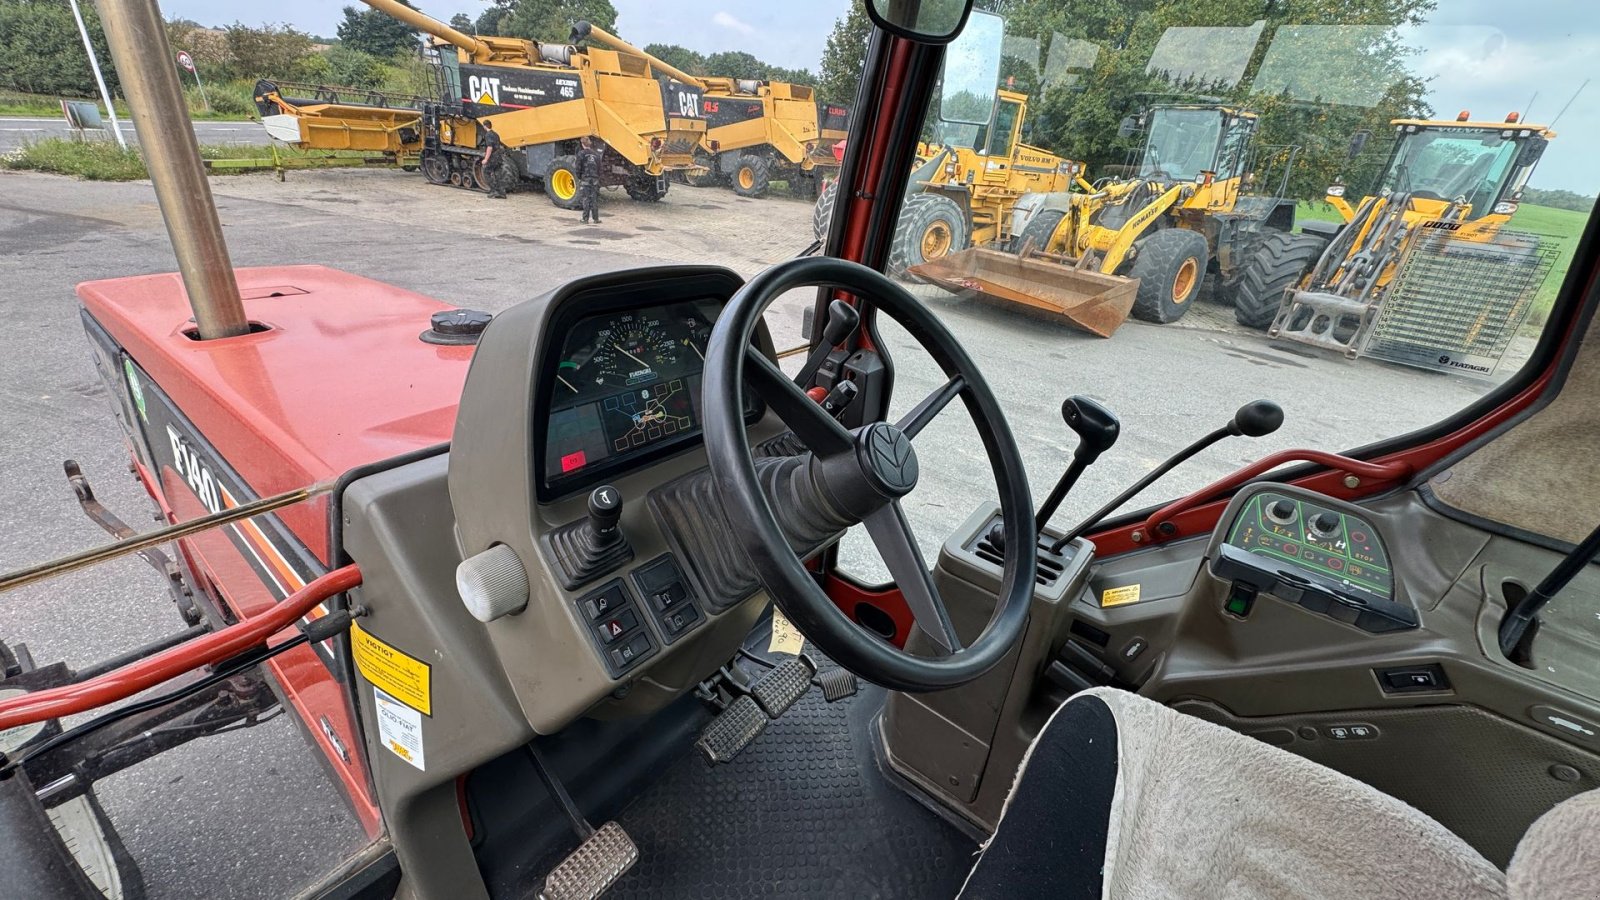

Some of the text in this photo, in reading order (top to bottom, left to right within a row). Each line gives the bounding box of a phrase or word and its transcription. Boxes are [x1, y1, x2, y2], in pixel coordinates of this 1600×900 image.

[468, 75, 500, 106] CAT
[560, 86, 574, 98] 465
[678, 91, 699, 118] CAT
[1020, 155, 1040, 163] VOLVO
[1132, 206, 1158, 229] KOMATSU
[1423, 221, 1461, 231] FIAT
[1449, 361, 1490, 373] FIATAGRI
[166, 424, 221, 513] F140
[1355, 552, 1374, 562] STOP
[365, 637, 394, 658] VIGTIGT
[399, 720, 413, 732] FIAT
